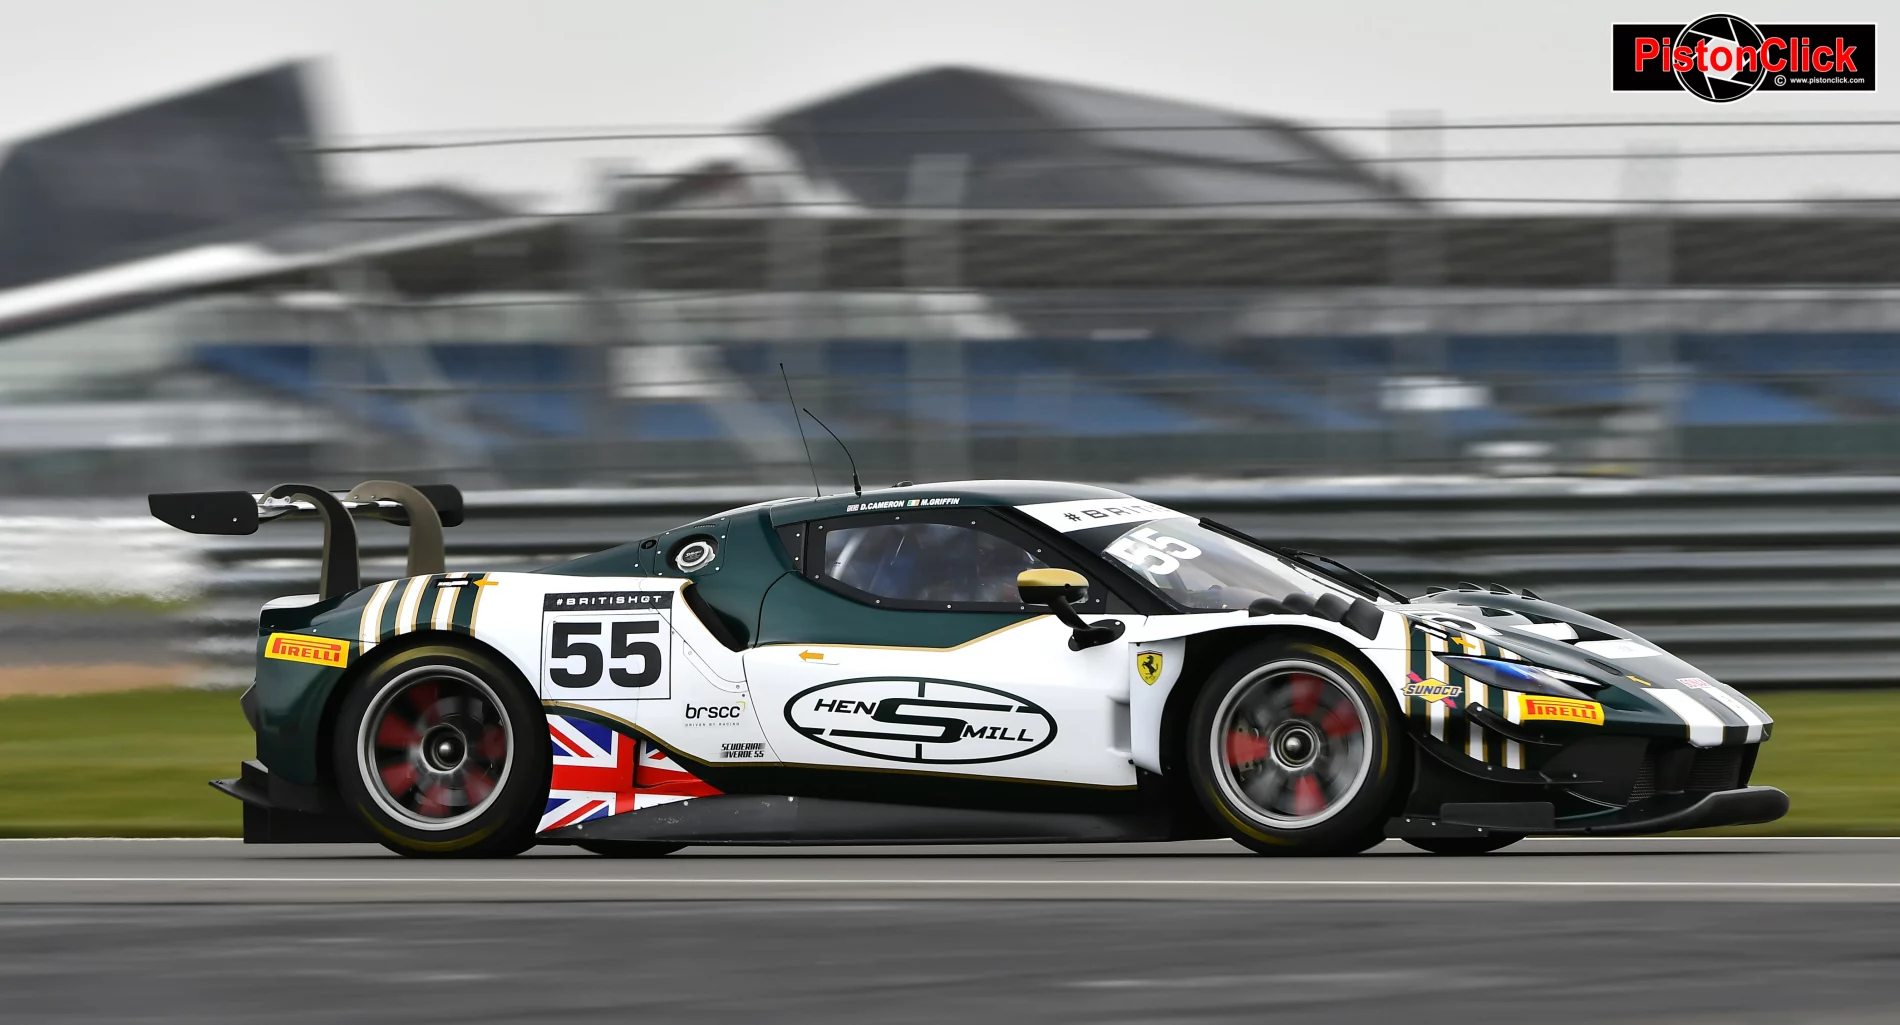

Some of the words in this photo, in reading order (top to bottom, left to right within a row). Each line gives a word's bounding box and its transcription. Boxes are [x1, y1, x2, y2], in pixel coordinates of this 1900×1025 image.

[860, 500, 904, 510] D.CAMERON
[1105, 526, 1202, 575] 55
[272, 637, 342, 662] PIRELLI
[549, 620, 662, 689] 55
[1406, 684, 1459, 696] SUNOCO
[685, 703, 740, 719] brscc
[1526, 699, 1597, 720] PIRELLI
